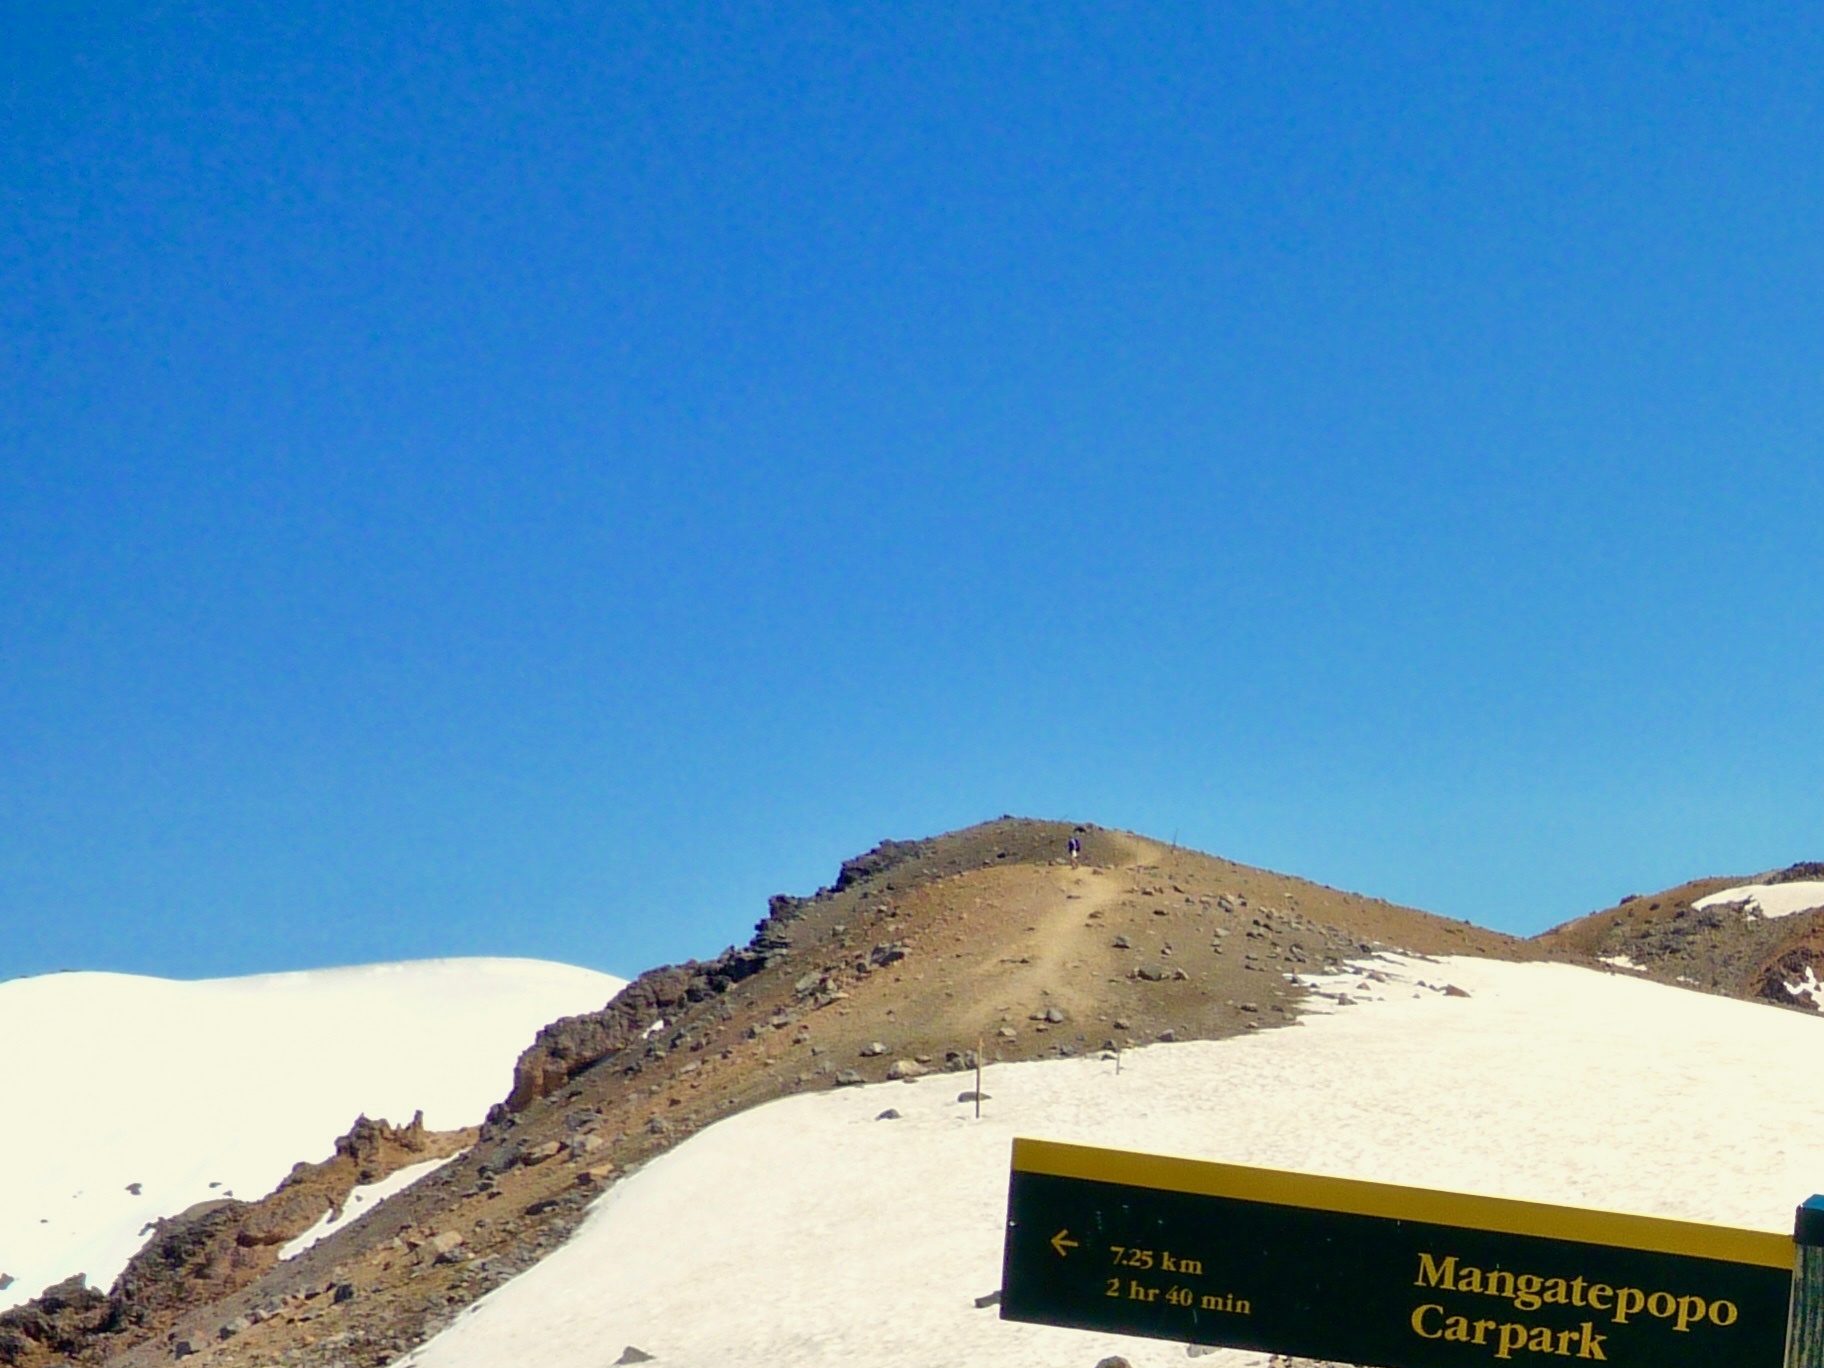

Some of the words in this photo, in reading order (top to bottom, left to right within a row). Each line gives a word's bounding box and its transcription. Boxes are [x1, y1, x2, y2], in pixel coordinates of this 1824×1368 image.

[1109, 1246, 1154, 1269] 7.25
[1161, 1251, 1203, 1275] km
[1106, 1278, 1119, 1297] 2
[1129, 1280, 1159, 1301] hr
[1165, 1285, 1193, 1307] 40
[1201, 1293, 1251, 1315] min
[1413, 1253, 1738, 1332] Mangatepopo
[1411, 1304, 1608, 1361] Carpark
